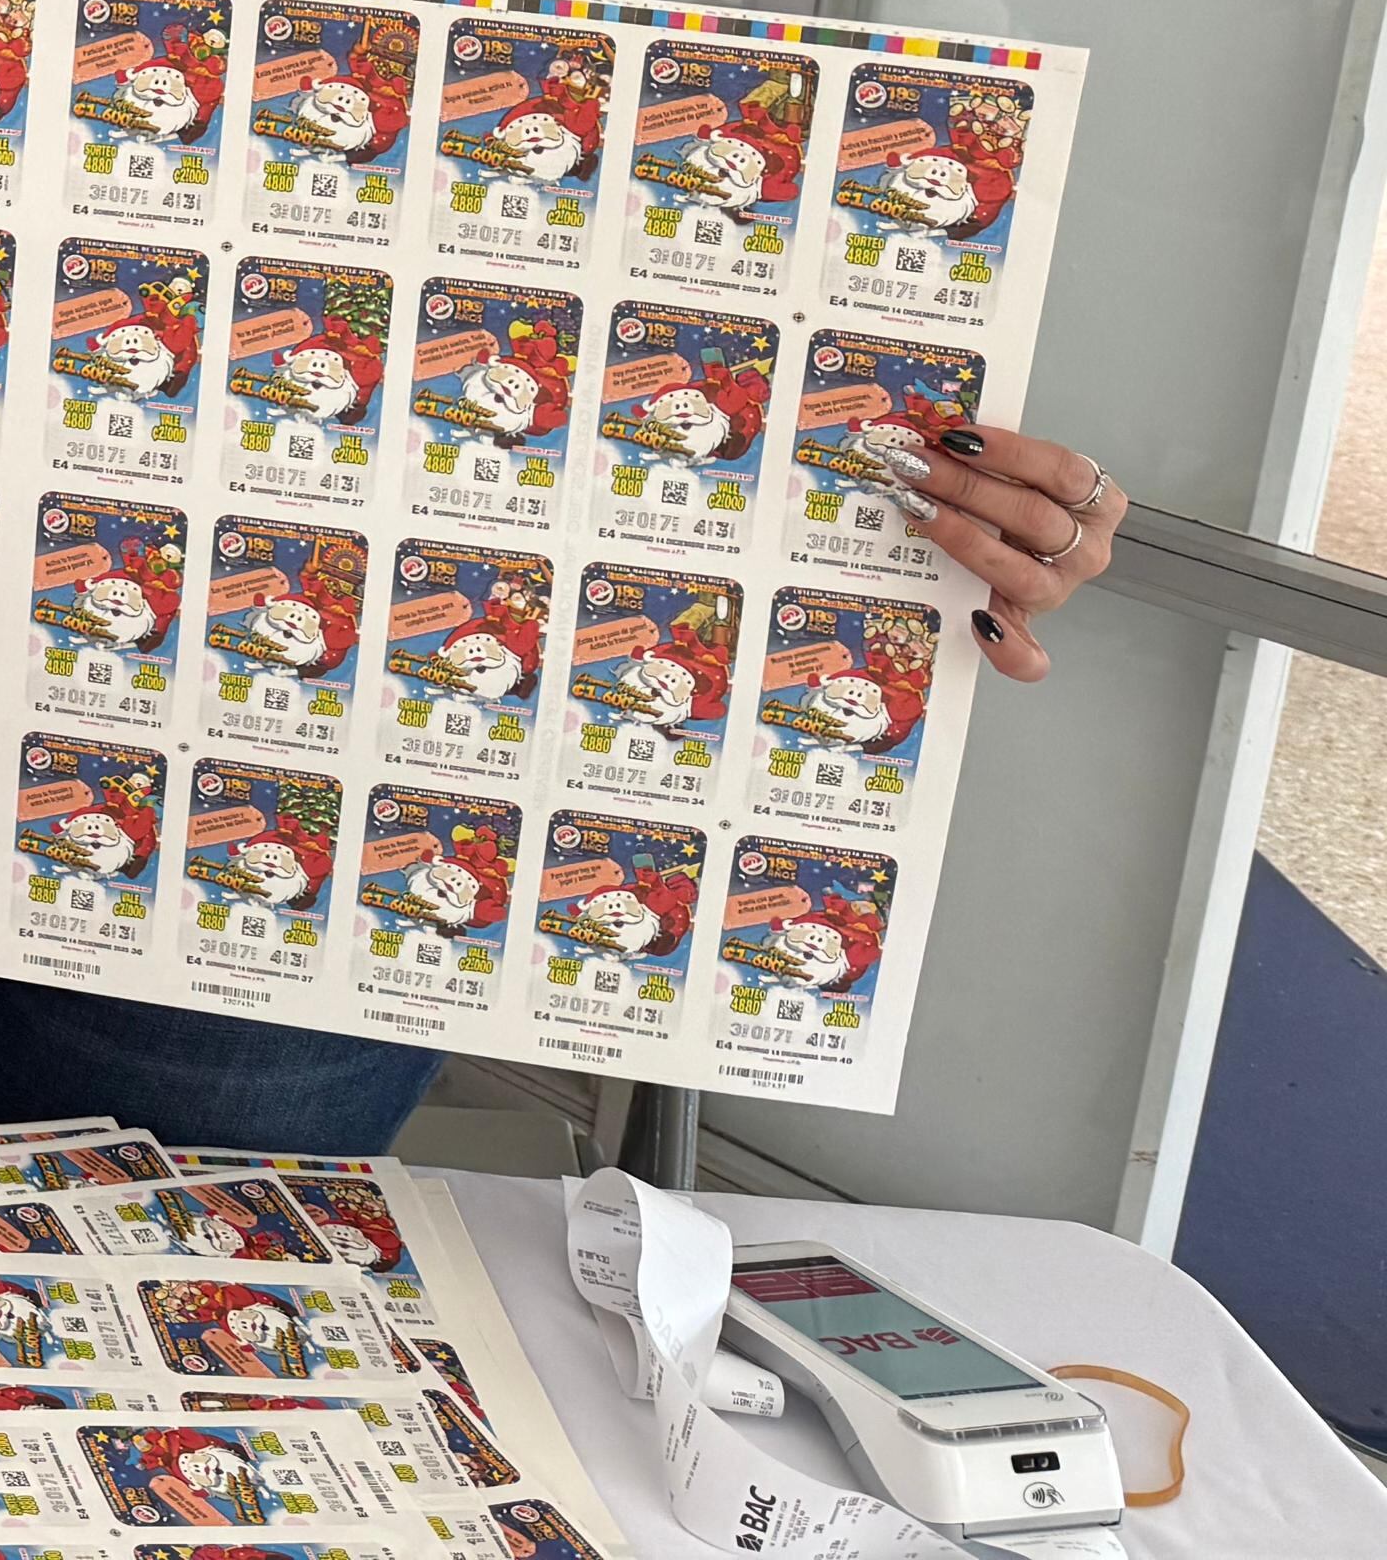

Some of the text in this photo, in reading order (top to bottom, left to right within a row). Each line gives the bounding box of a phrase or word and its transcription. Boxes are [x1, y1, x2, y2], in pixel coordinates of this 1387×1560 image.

[252, 222, 269, 234] E4
[644, 220, 677, 237] 4880
[754, 223, 778, 236] VALE
[438, 243, 455, 255] E4
[845, 249, 879, 267] 4880
[961, 252, 986, 266] VALE
[630, 267, 648, 278] E4
[763, 287, 777, 296] 24
[829, 295, 848, 307] E4
[853, 301, 890, 313] DOMINGO
[892, 306, 901, 315] 14
[903, 308, 946, 321] DICIEMBRE
[969, 317, 984, 327] 25
[820, 1330, 918, 1356] BAC
[740, 1485, 776, 1534] BAC
